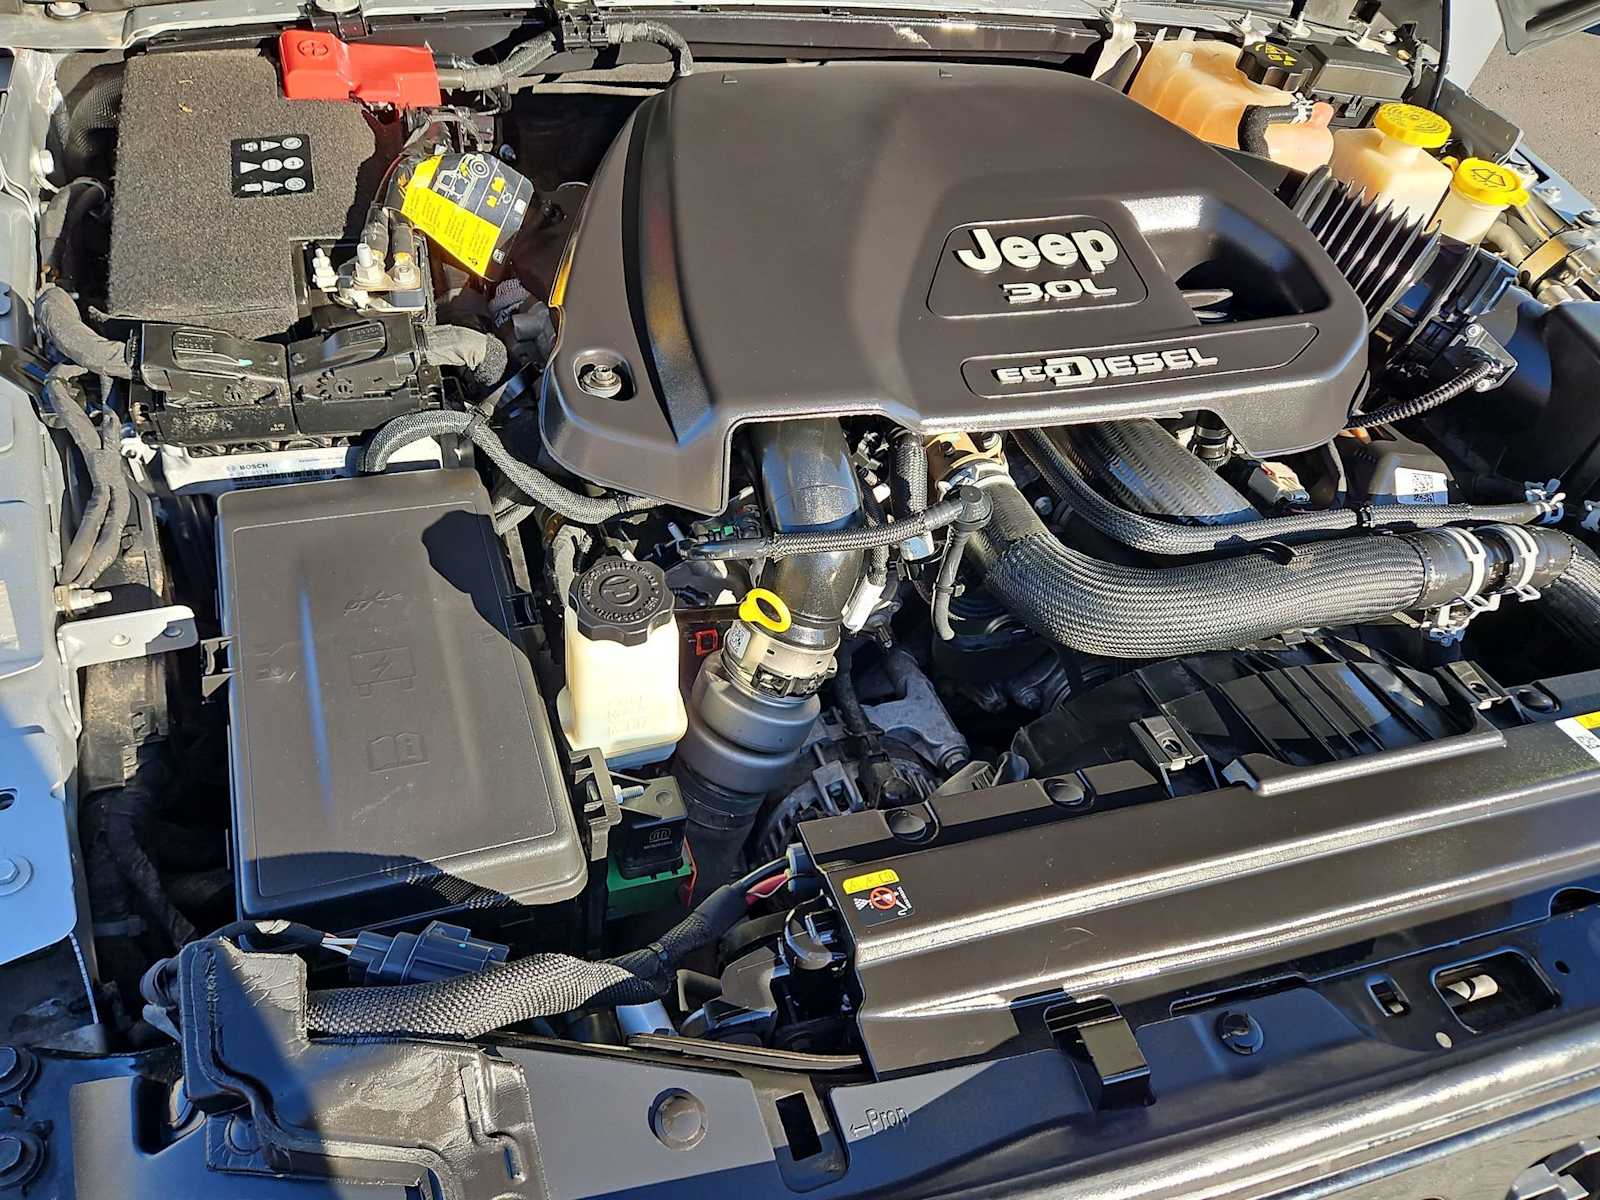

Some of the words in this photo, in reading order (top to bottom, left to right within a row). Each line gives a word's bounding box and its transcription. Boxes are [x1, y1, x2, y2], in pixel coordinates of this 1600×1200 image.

[957, 228, 1119, 274] Jeep
[1003, 278, 1117, 304] 3.0L
[239, 462, 270, 471] BOSCH
[865, 1107, 909, 1134] Prop
